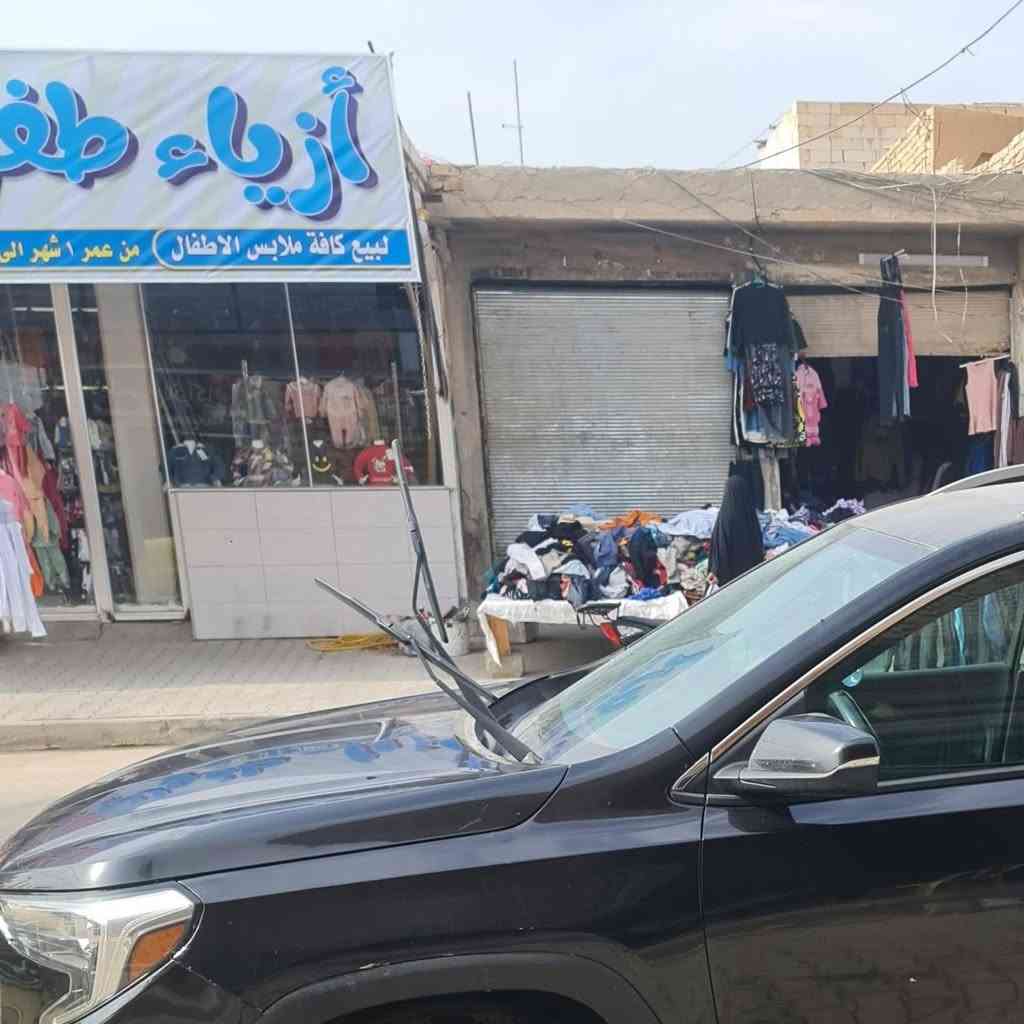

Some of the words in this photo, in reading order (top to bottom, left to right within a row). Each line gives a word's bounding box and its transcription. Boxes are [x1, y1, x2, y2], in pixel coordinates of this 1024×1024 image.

[0, 79, 134, 186] طف
[154, 65, 375, 219] أزياء
[30, 233, 61, 263] شهر
[81, 243, 113, 263] عمر
[119, 239, 140, 263] من
[171, 232, 240, 262] الاطفال
[247, 234, 303, 262] ملابس
[306, 232, 345, 256] كافة
